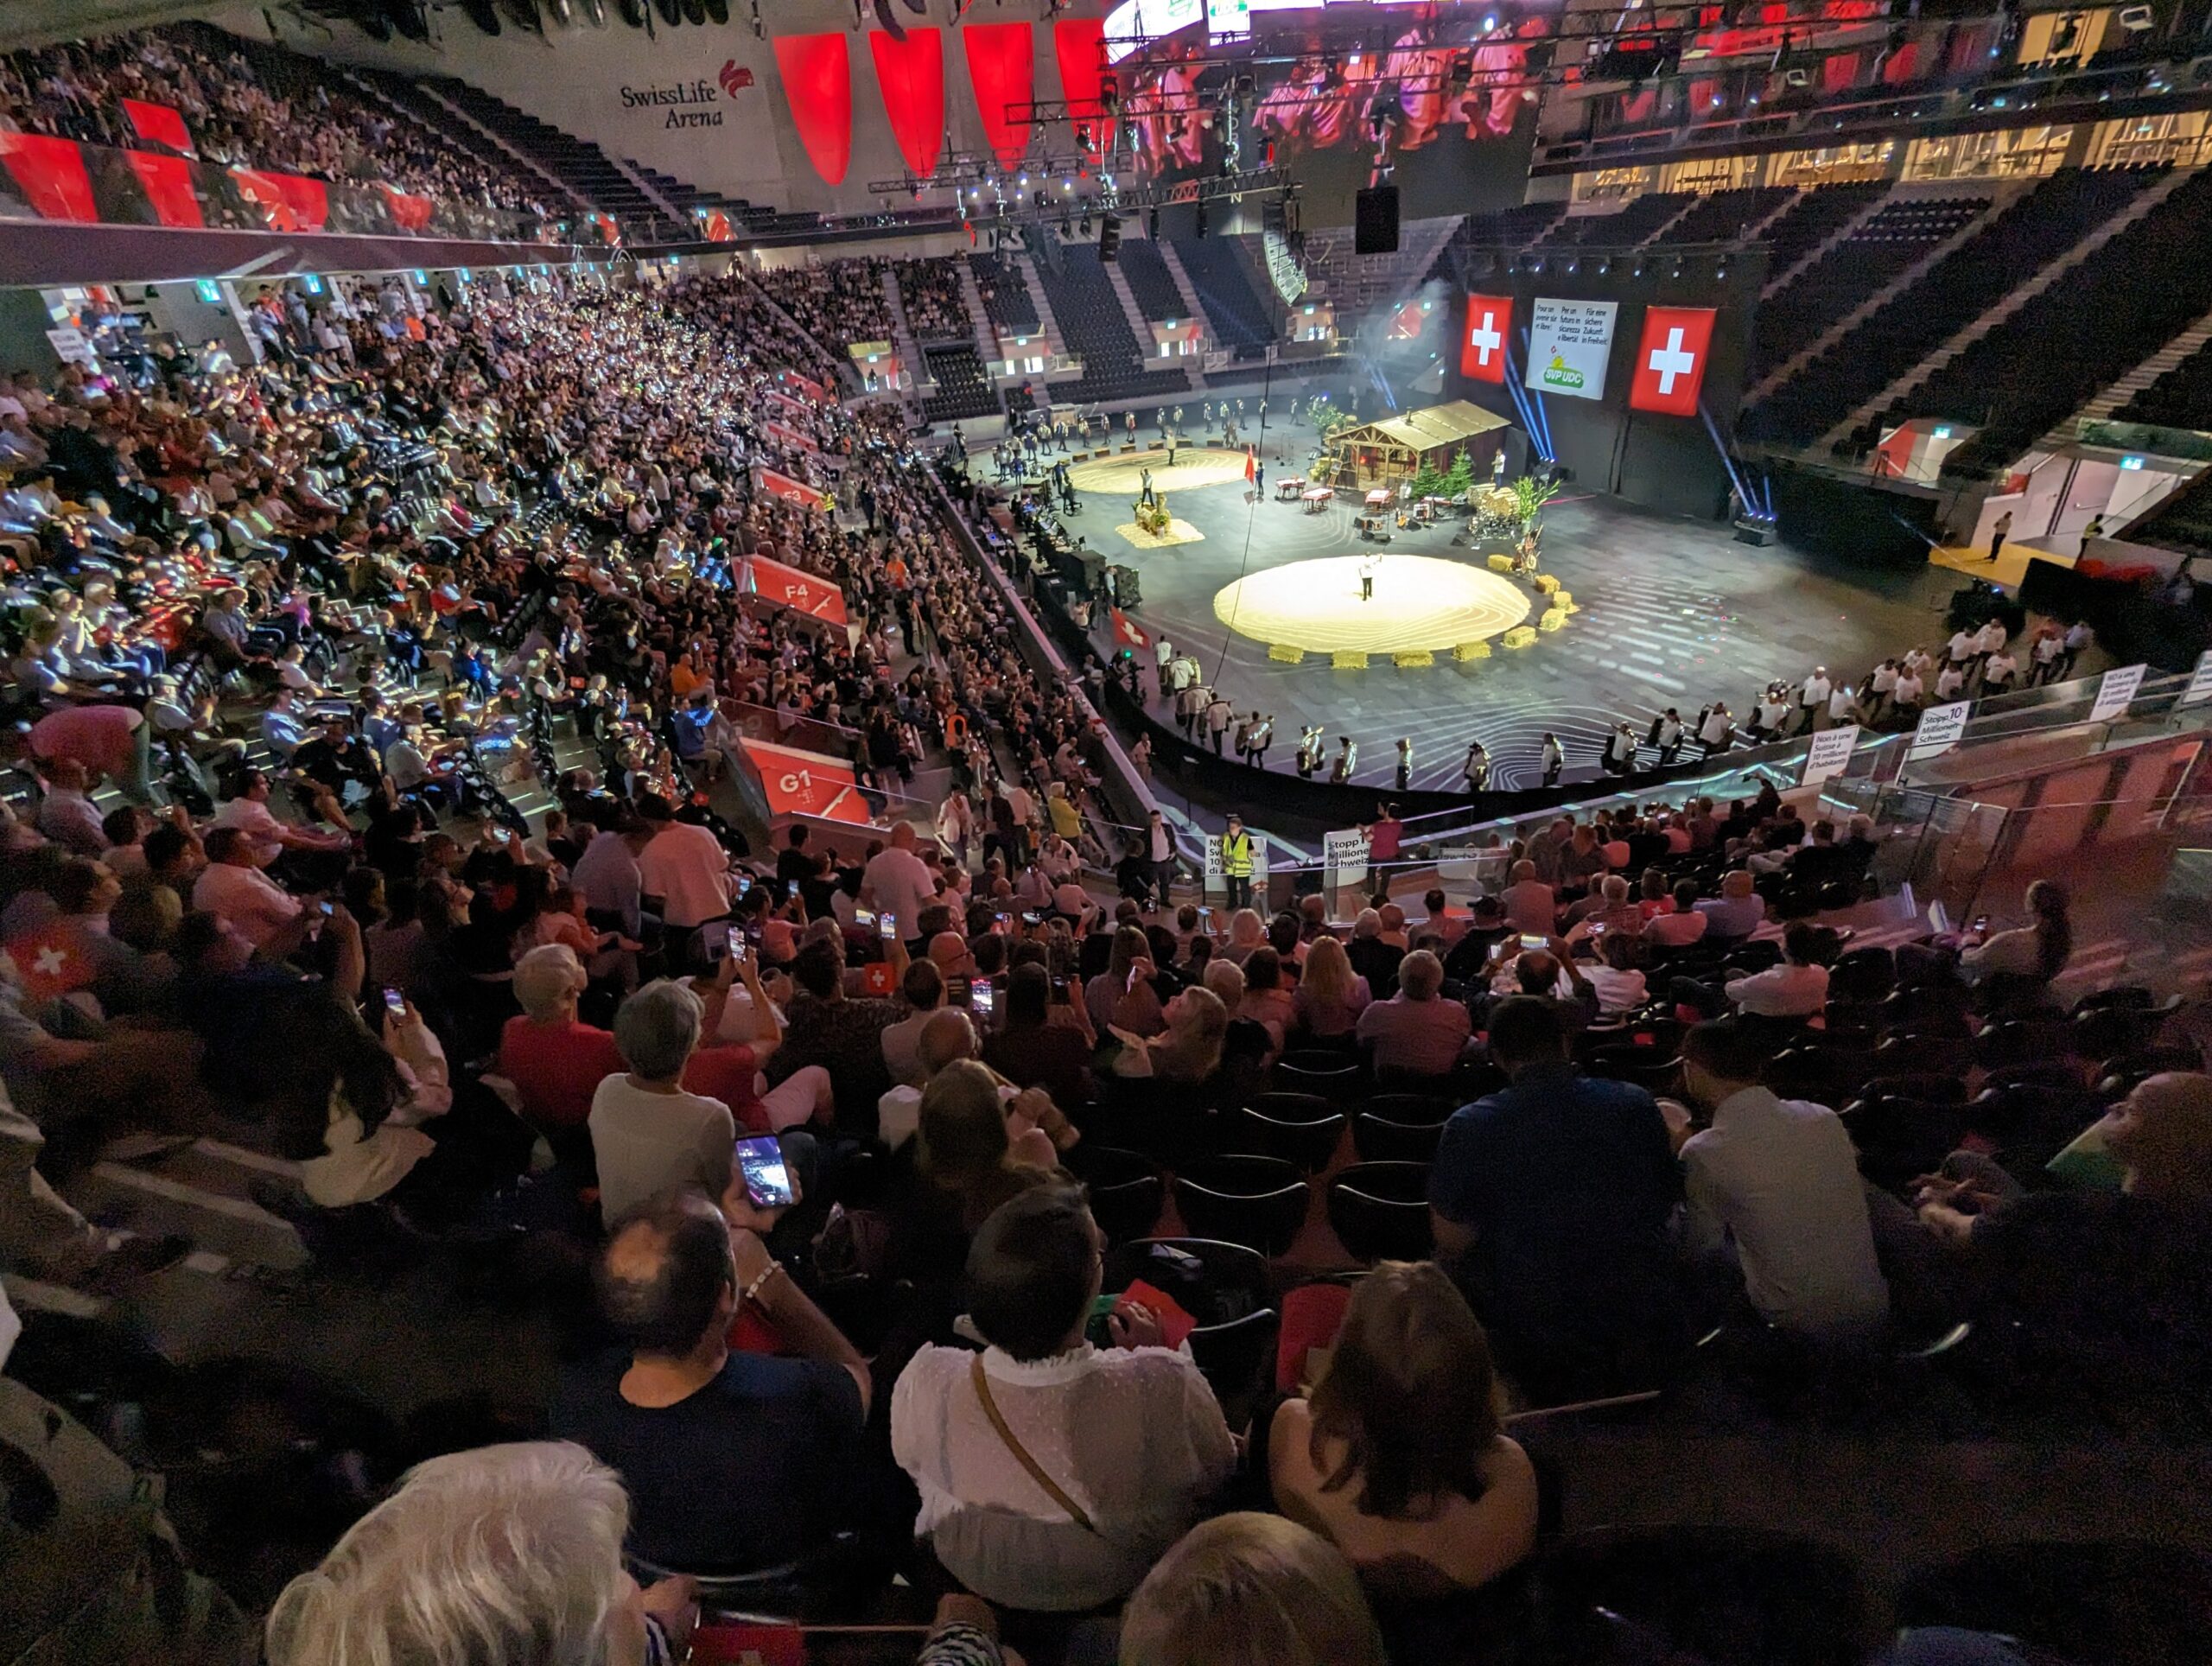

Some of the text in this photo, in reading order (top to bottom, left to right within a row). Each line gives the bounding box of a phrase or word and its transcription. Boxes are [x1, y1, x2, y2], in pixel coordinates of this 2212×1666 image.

[620, 79, 718, 108] SwissLife
[665, 108, 723, 129] Arena
[1546, 369, 1582, 384] SVP UDC
[785, 584, 809, 599] F4
[1924, 715, 1949, 725] Stopp
[1815, 743, 1836, 752] Suisse
[780, 769, 811, 793] G1
[1328, 839, 1359, 850] Stopp
[1209, 866, 1218, 874] di
